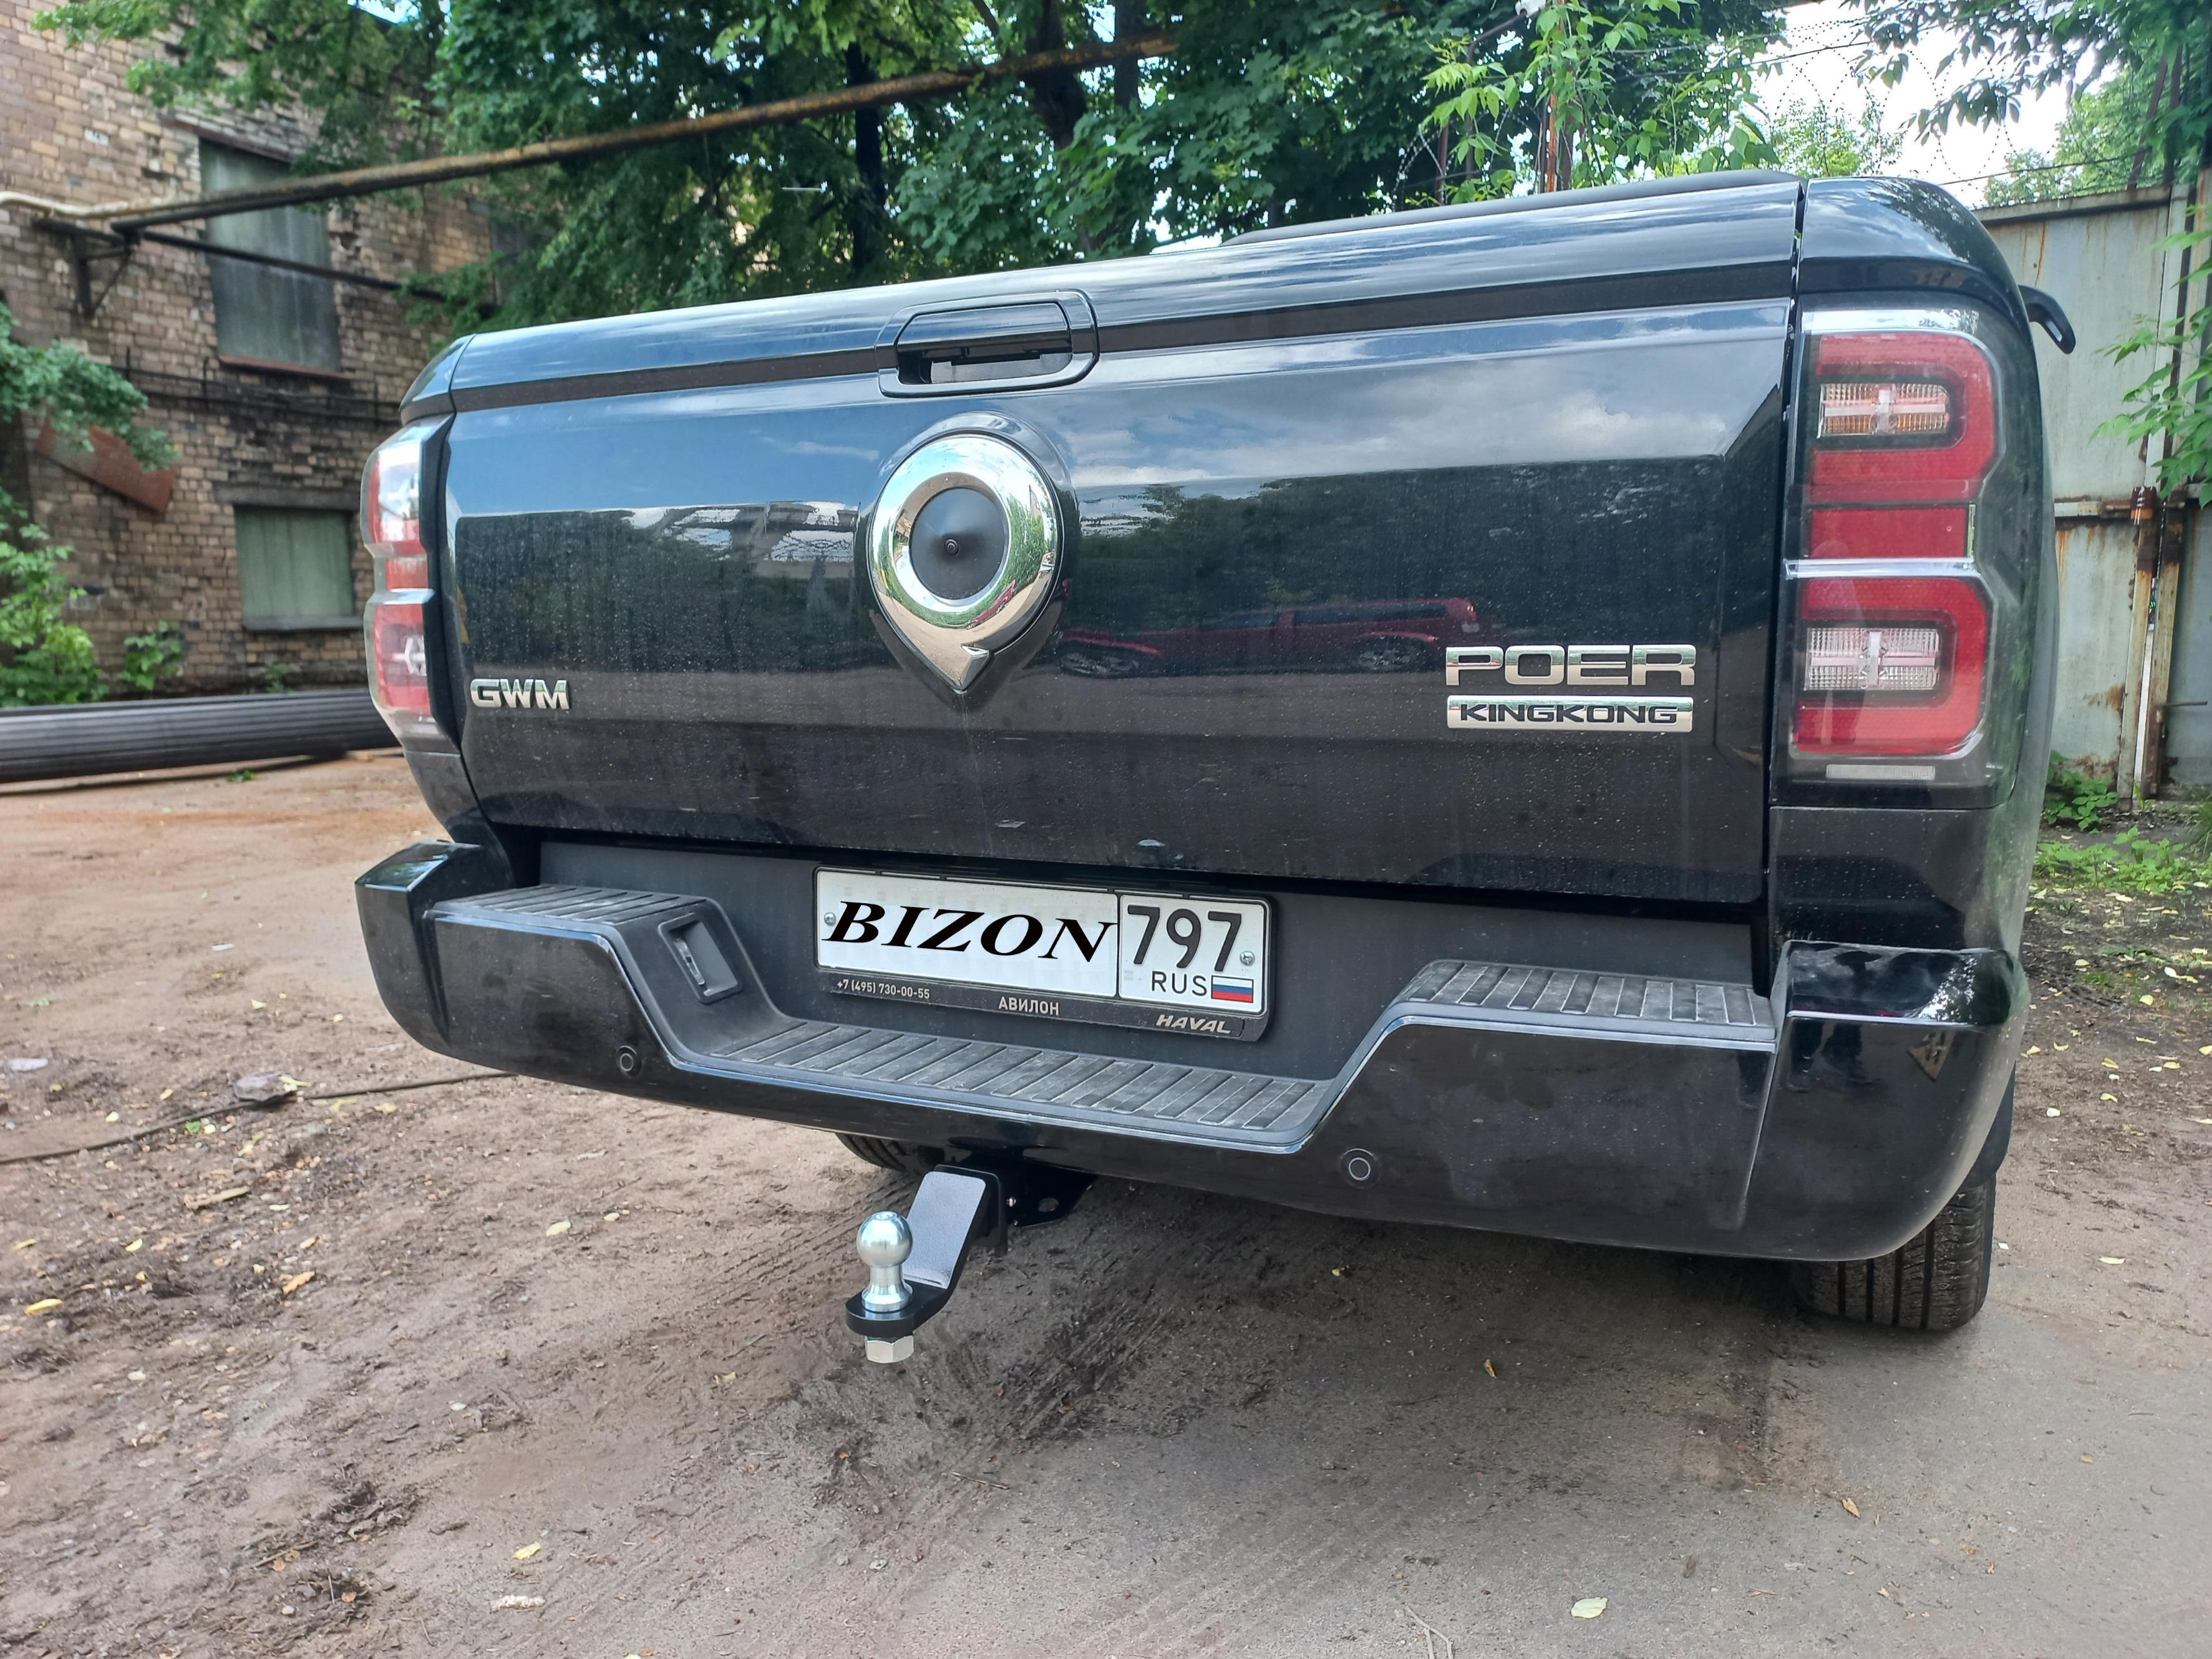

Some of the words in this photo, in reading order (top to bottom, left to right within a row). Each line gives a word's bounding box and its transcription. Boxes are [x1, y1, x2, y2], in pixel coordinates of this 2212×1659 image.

[1445, 644, 1696, 685] POER
[470, 678, 570, 710] GWM
[1460, 704, 1677, 724] KINGKONG
[1127, 904, 1242, 972] 797
[837, 979, 849, 989] +7
[851, 981, 876, 994] (495)
[878, 983, 930, 999] 730-00-55
[1152, 970, 1208, 997] RUS
[998, 996, 1060, 1016] АВИЛОН
[1156, 1014, 1231, 1034] HAVAL
